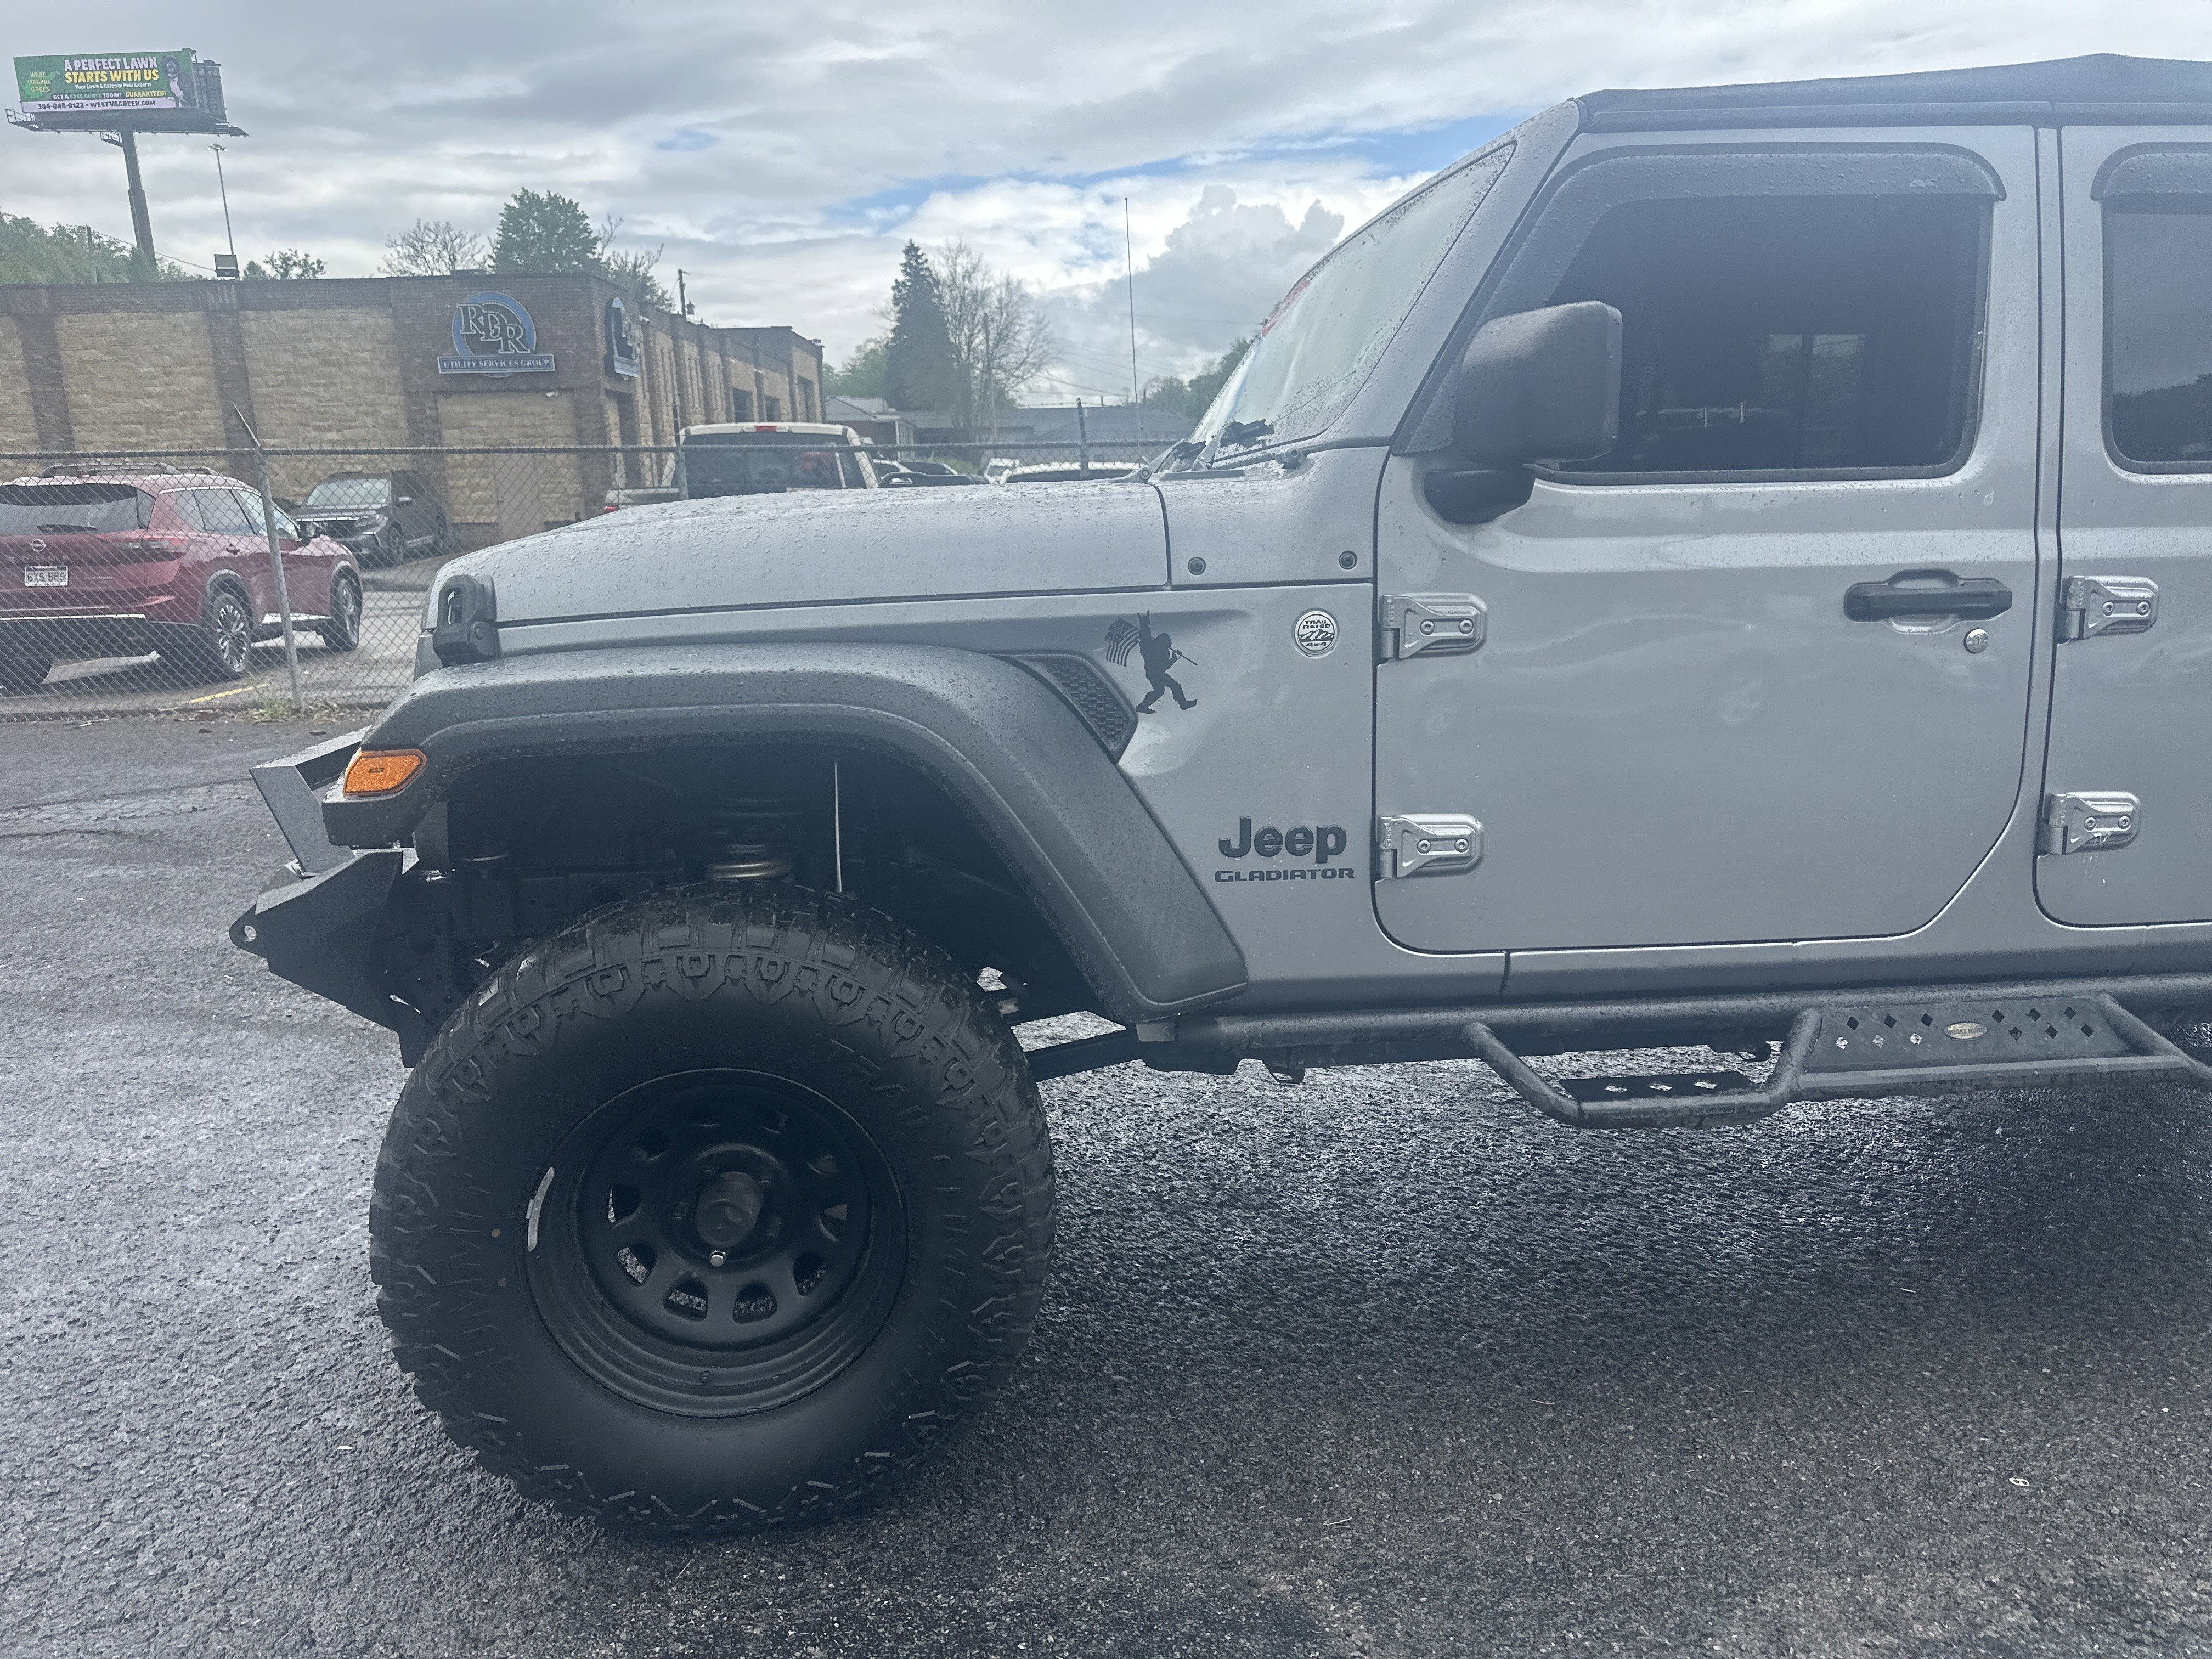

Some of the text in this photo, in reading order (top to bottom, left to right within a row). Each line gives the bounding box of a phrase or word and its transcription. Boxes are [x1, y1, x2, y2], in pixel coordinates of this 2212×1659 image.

[65, 57, 157, 71] A PERFECT LAWN
[65, 69, 159, 83] STARTS WITH US
[443, 358, 549, 368] UTILITY SERVICES GROUP
[1218, 815, 1347, 864] Jeep
[1215, 868, 1356, 882] GLADIATOR
